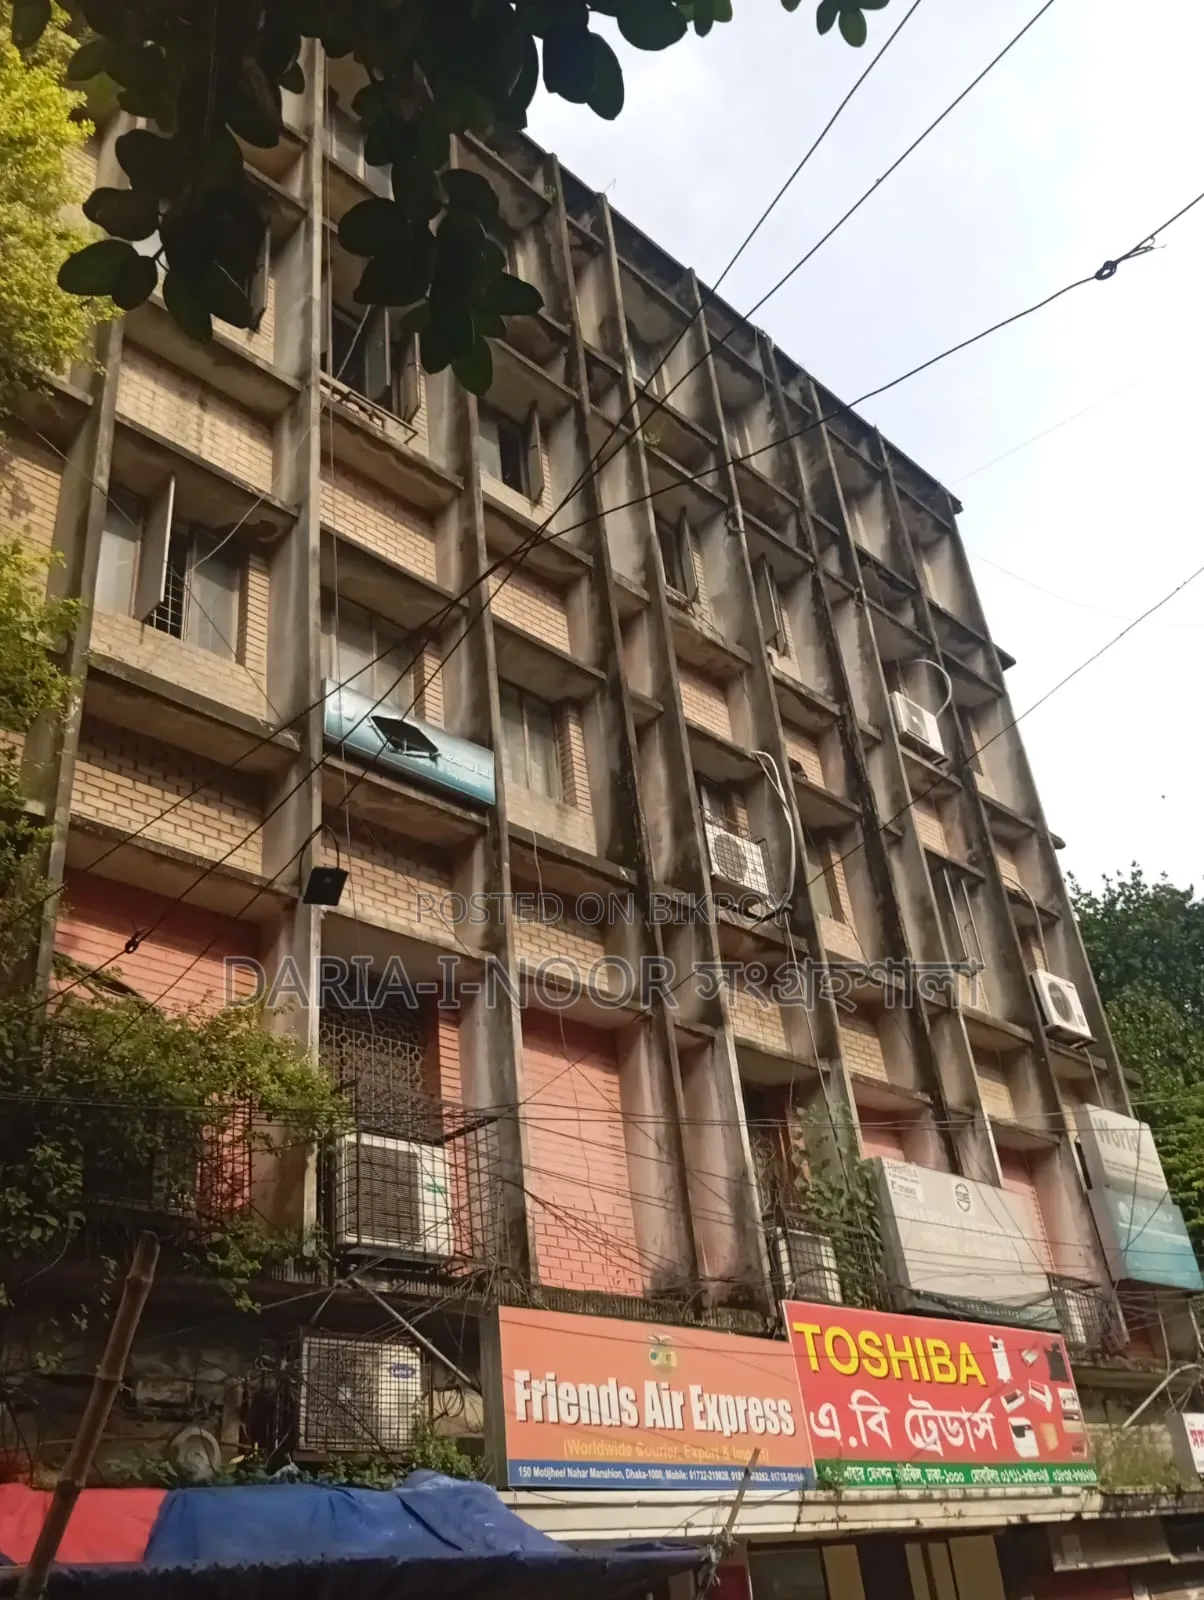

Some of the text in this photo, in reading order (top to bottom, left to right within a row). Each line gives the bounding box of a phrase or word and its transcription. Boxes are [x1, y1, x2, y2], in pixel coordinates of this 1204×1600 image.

[792, 1322, 988, 1387] TOSHIBA
[513, 1369, 797, 1438] Friends Air Express
[518, 1466, 532, 1477] 150
[567, 1468, 588, 1478] Nahar
